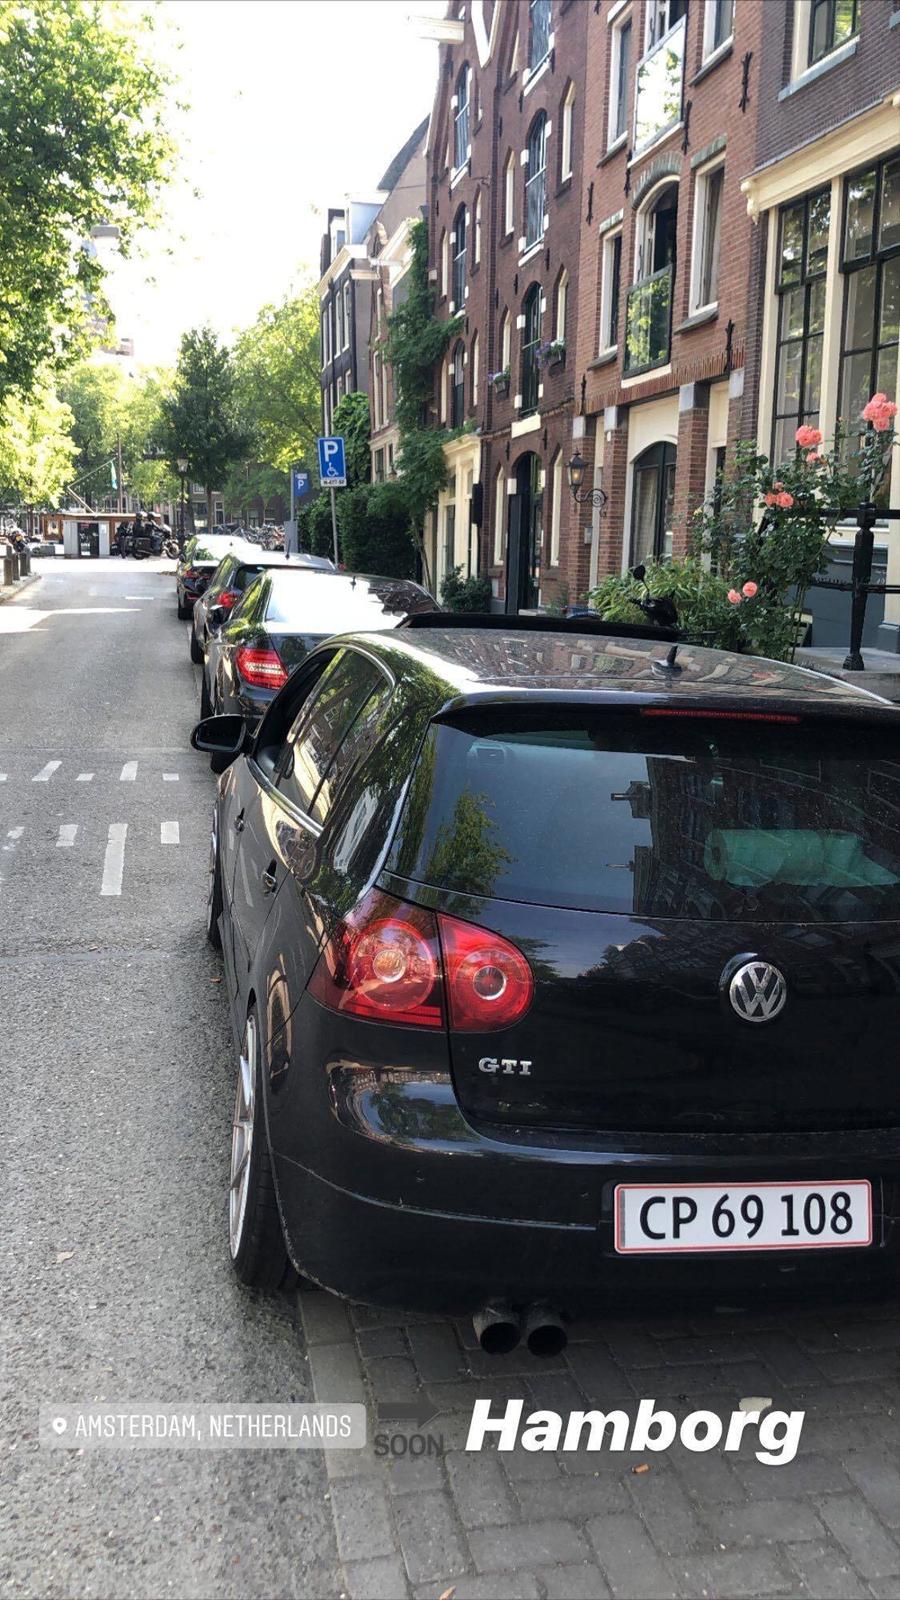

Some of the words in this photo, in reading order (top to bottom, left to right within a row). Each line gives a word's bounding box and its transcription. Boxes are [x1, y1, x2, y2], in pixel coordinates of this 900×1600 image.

[323, 441, 339, 463] P
[297, 479, 305, 489] P
[478, 1057, 533, 1076] GTI
[639, 1196, 698, 1240] CP
[711, 1193, 764, 1239] 69
[780, 1191, 853, 1237] 108
